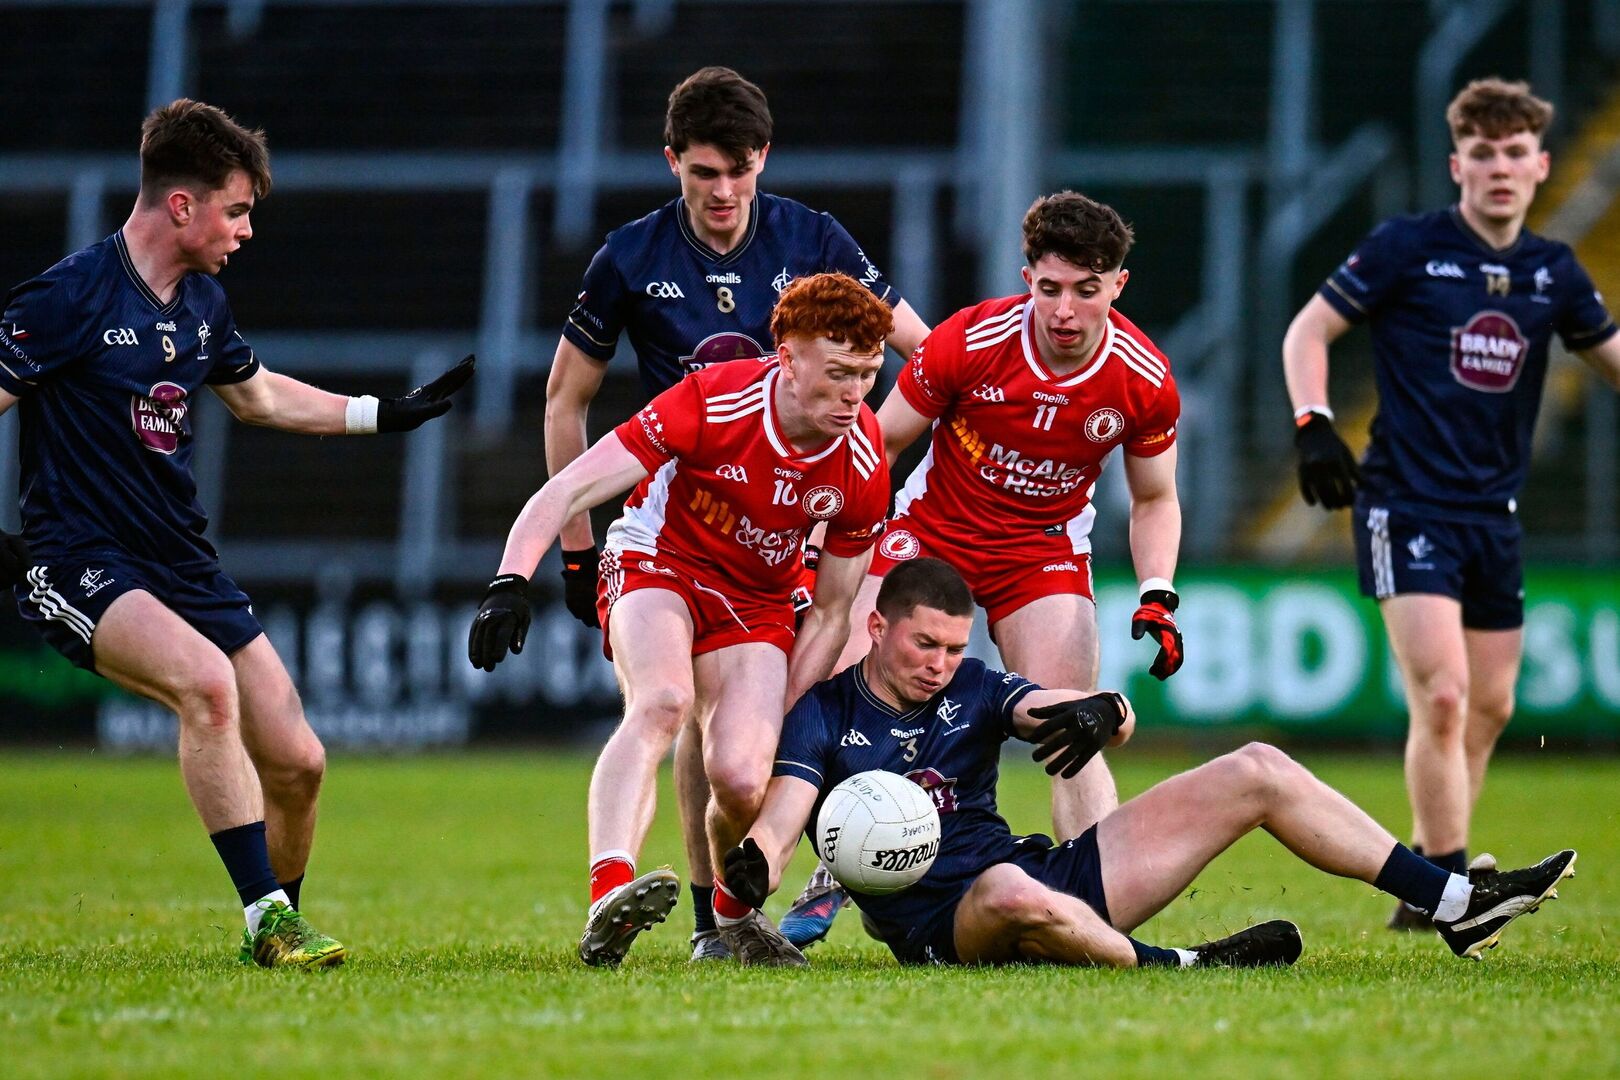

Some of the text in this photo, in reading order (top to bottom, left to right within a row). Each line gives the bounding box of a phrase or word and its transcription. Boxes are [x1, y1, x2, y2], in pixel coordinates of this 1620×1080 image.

[717, 286, 736, 313] 8
[162, 335, 177, 362] 9
[1460, 333, 1521, 360] BRADY
[1461, 355, 1513, 376] FAMILY
[141, 415, 177, 432] FAMIL
[1033, 404, 1058, 431] 11
[772, 480, 798, 506] 10
[900, 737, 918, 762] 3
